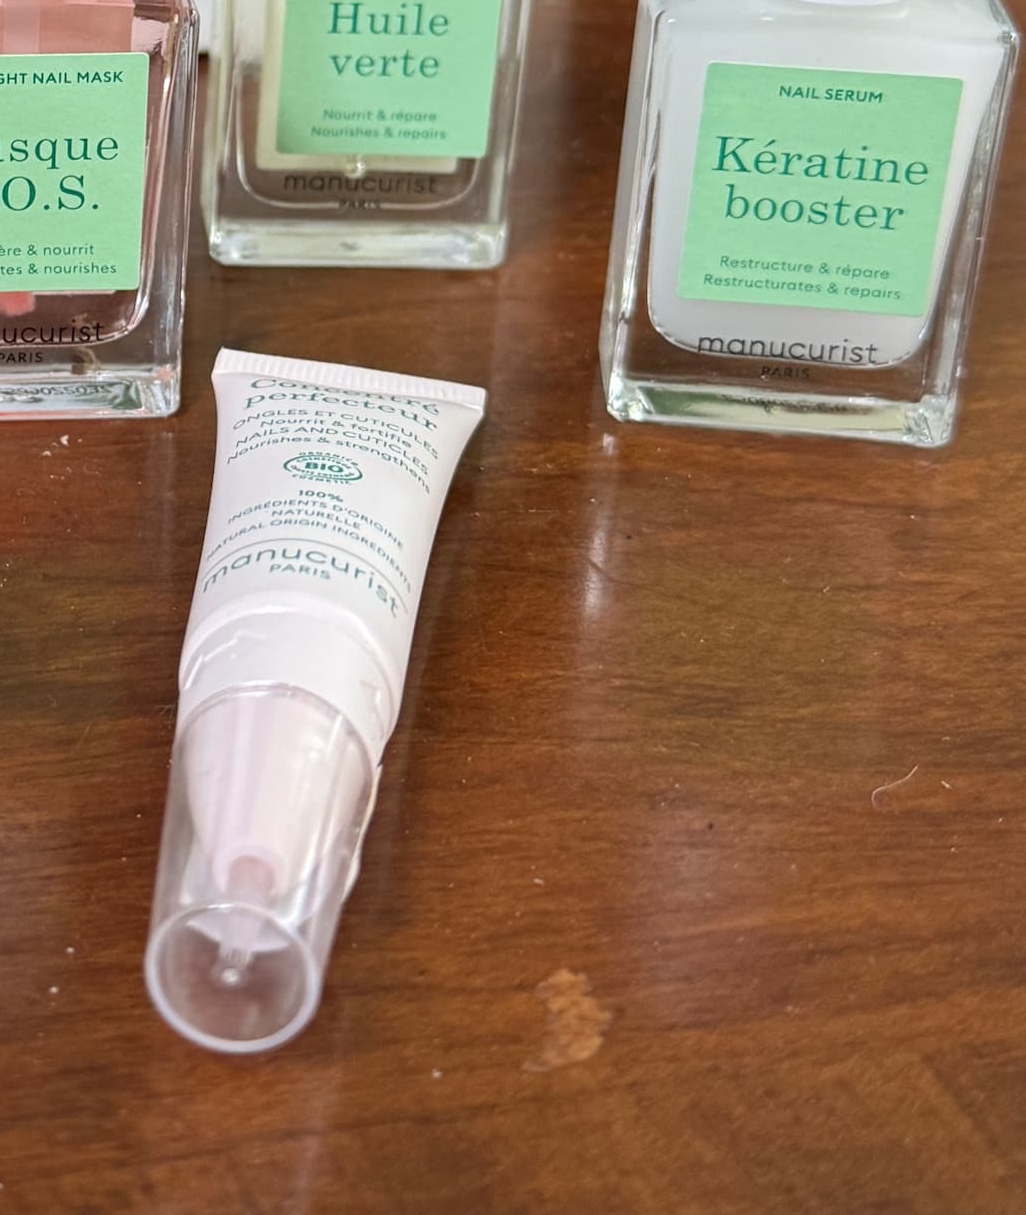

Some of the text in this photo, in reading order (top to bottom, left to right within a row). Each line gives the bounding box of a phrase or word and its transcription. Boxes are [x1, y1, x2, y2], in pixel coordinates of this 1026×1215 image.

[327, 2, 449, 38] Huile
[329, 49, 440, 78] verte
[32, 72, 72, 84] NAIL
[76, 71, 123, 83] MASK
[779, 85, 883, 103] NAIL SERUM
[323, 109, 372, 121] Nourrit
[376, 110, 386, 121] &
[311, 126, 447, 141] Nourishes & repairs
[712, 136, 929, 186] Kératine
[283, 174, 440, 194] manucurist
[724, 184, 904, 231] booster
[27, 244, 38, 256] &
[43, 242, 94, 256] nourrit
[28, 263, 39, 275] &
[44, 261, 117, 275] nourishes
[720, 255, 890, 280] Restructure & répare
[703, 273, 901, 300] Restructurates & repairs
[697, 335, 878, 364] manucurist
[760, 365, 811, 379] PARIS
[244, 390, 439, 432] perfecteur
[233, 408, 308, 430] ONGLES
[340, 413, 439, 460] CUTICULES
[260, 419, 412, 449] Nourrit & fortifie
[227, 434, 311, 465] Nourishes
[336, 439, 431, 495] strengthens
[235, 427, 290, 448] NAILS
[295, 426, 338, 435] AND
[343, 430, 428, 476] CUTICLES
[305, 461, 343, 473] BIO
[298, 489, 343, 502] 100%
[271, 509, 361, 530] NATURELLE
[332, 503, 404, 550] D'ORIGINE
[206, 522, 265, 563] NATURAL
[270, 518, 327, 529] ORIGIN
[202, 547, 399, 618] manucurist
[269, 563, 332, 580] PARIS
